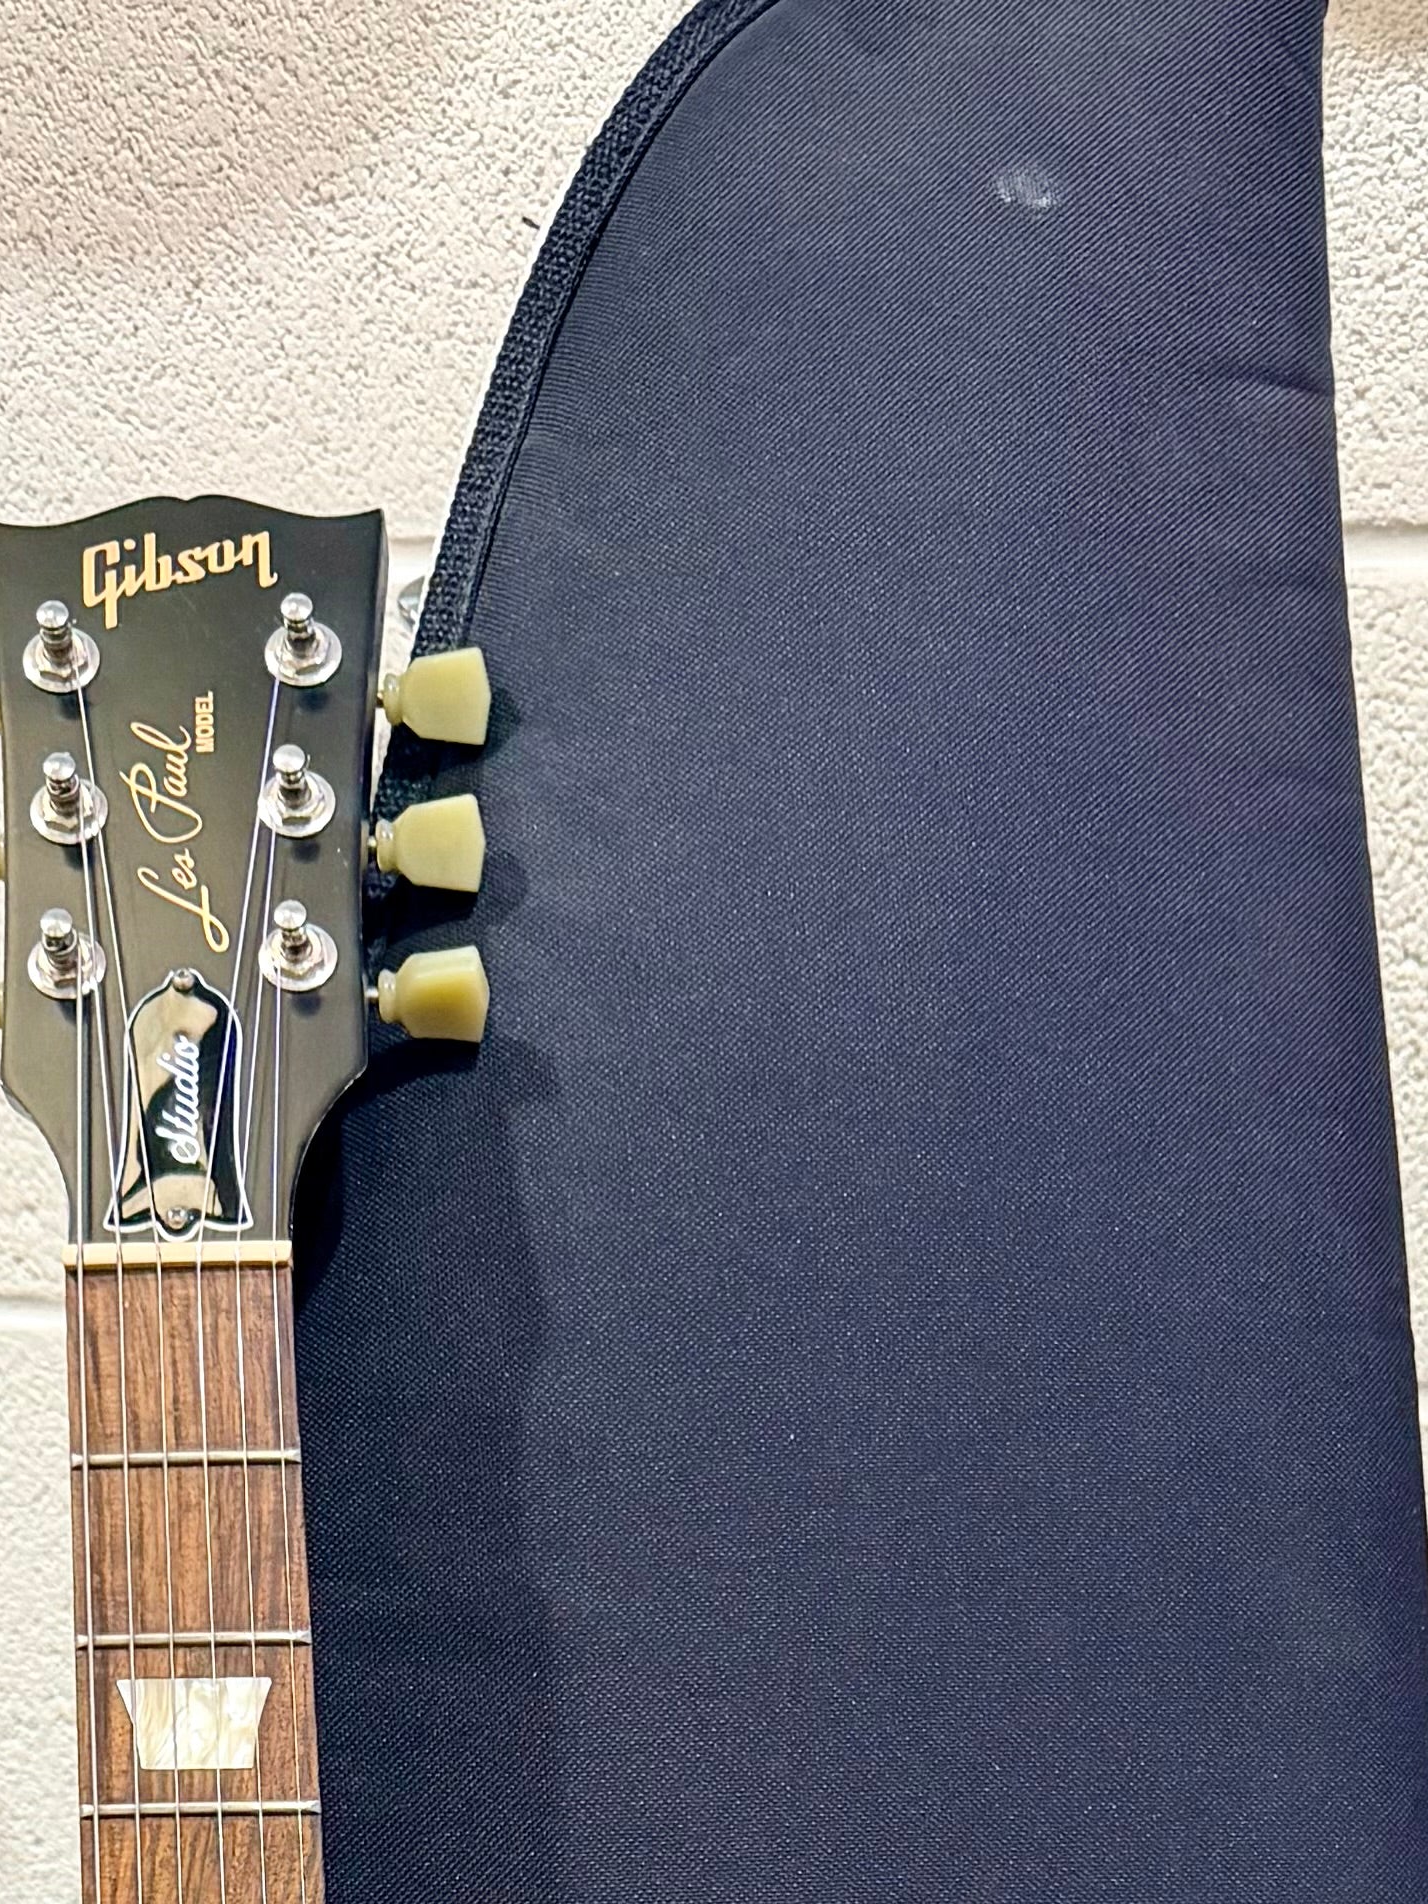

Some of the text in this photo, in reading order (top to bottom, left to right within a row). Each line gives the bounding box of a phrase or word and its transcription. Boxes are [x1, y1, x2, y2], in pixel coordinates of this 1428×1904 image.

[82, 530, 278, 629] Gibson
[195, 690, 215, 754] MODEL
[119, 720, 230, 953] Les Paul
[156, 1035, 201, 1166] Studio
